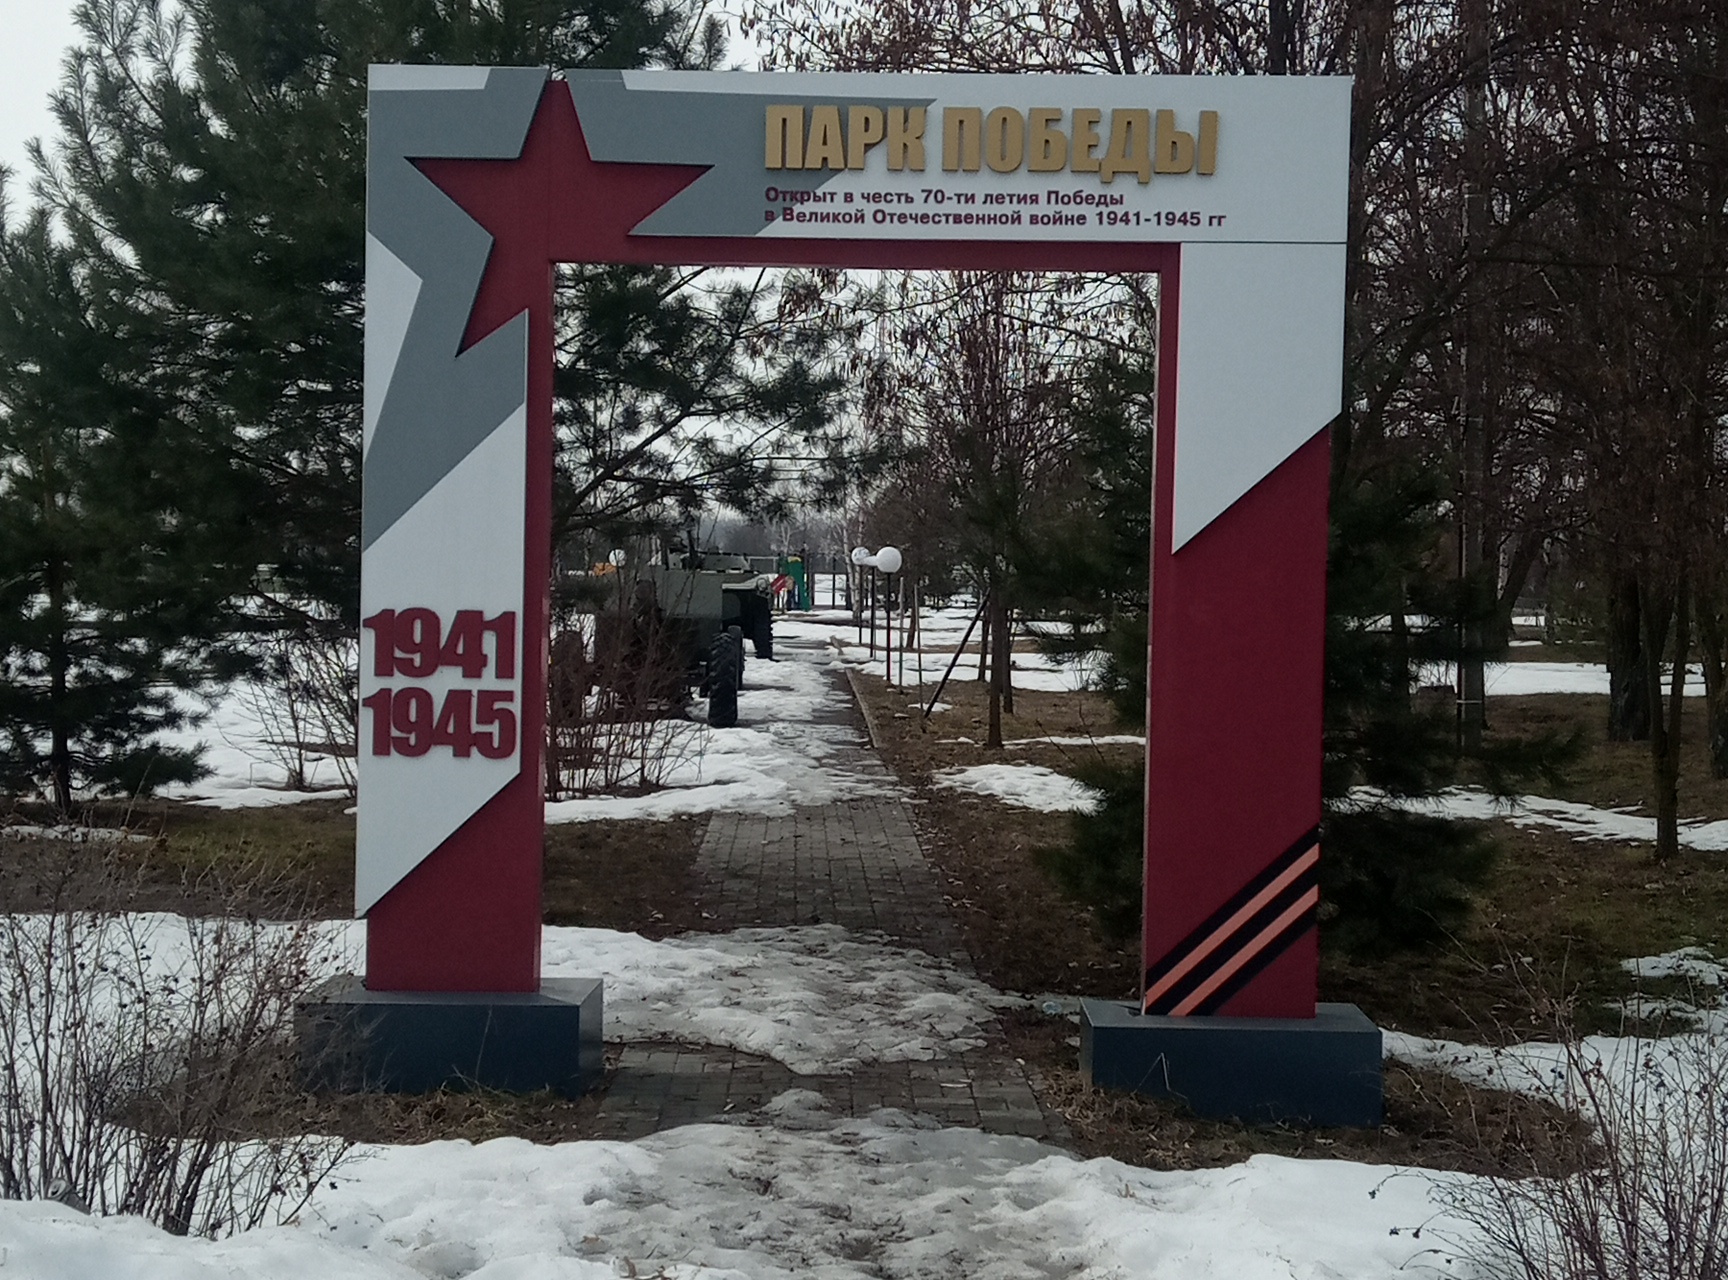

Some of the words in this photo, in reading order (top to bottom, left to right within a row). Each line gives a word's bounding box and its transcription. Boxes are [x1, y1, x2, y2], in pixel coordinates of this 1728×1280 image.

[765, 104, 926, 172] ПАРК
[942, 106, 1218, 184] ПОБЕДЫ
[765, 188, 837, 206] Открыт
[843, 192, 854, 204] в
[860, 192, 915, 204] честь
[921, 189, 976, 204] 70-ти
[983, 192, 1039, 205] летия
[1046, 190, 1124, 207] Победы
[765, 210, 776, 222] в
[782, 207, 865, 224] Великой
[872, 209, 1022, 226] Отечественной
[1029, 210, 1087, 226] войне
[1096, 210, 1201, 226] 1941-1945
[1208, 214, 1227, 227] гг
[362, 607, 516, 680] 1941
[362, 687, 517, 760] 1945
